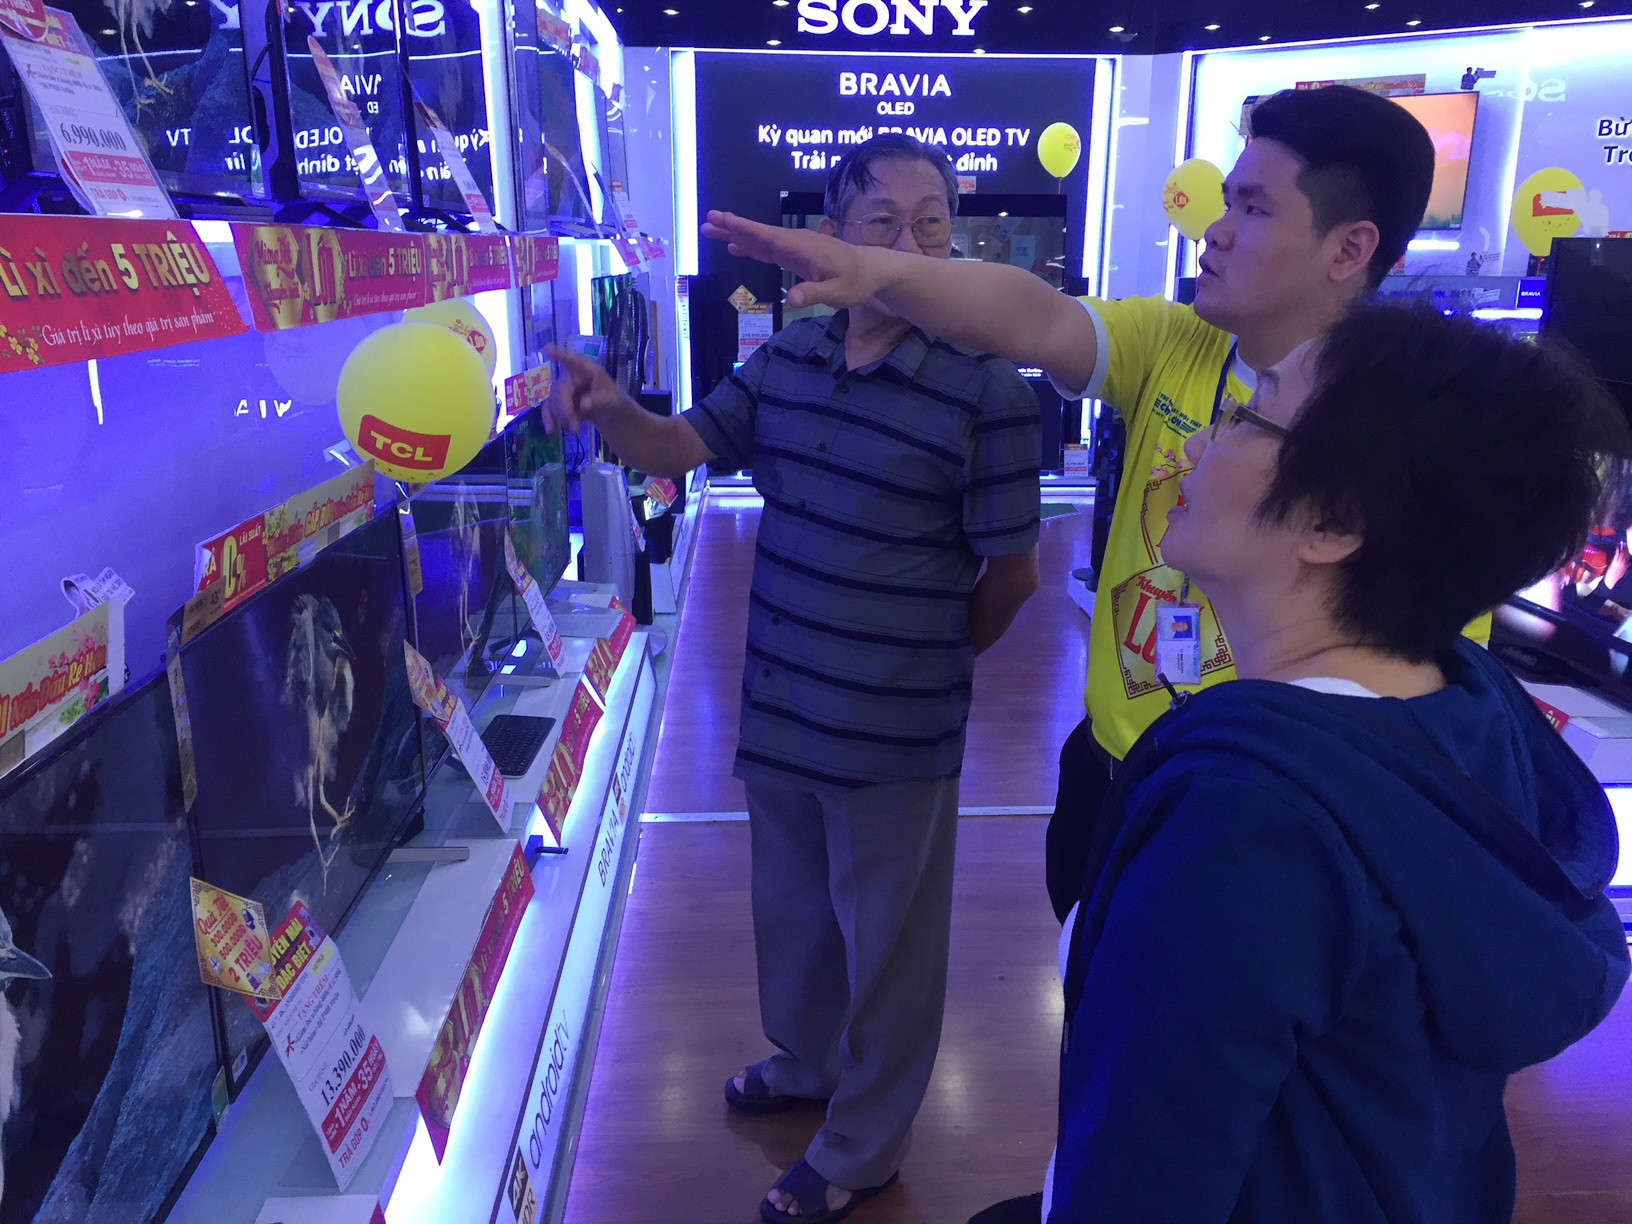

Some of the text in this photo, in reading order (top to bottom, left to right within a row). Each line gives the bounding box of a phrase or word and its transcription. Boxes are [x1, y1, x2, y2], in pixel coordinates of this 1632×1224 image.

[797, 0, 988, 36] SONY
[839, 72, 952, 97] BRAVIA
[877, 102, 915, 115] OLED
[60, 122, 127, 151] 6.990.000
[759, 124, 782, 147] Kỳ
[785, 128, 833, 147] quan
[838, 125, 873, 144] mới
[952, 127, 1001, 146] OLED
[1005, 128, 1031, 147] TV
[25, 246, 62, 296] xì
[62, 240, 118, 293] đến
[110, 243, 140, 291] 5
[132, 230, 212, 297] TRIỆU
[388, 247, 396, 276] 5
[398, 240, 422, 282] TRIỆU
[42, 323, 66, 347] Giá
[67, 325, 82, 346] trị
[123, 313, 144, 337] theo
[370, 430, 434, 463] TCL
[597, 808, 620, 888] BRAVIA
[197, 909, 218, 935] Quà
[228, 934, 264, 983] 2 TRIỆU
[321, 1024, 366, 1107] 13.390.000
[340, 1080, 359, 1110] NĂM
[357, 1060, 374, 1090] 35
[338, 1144, 352, 1169] TRẢ
